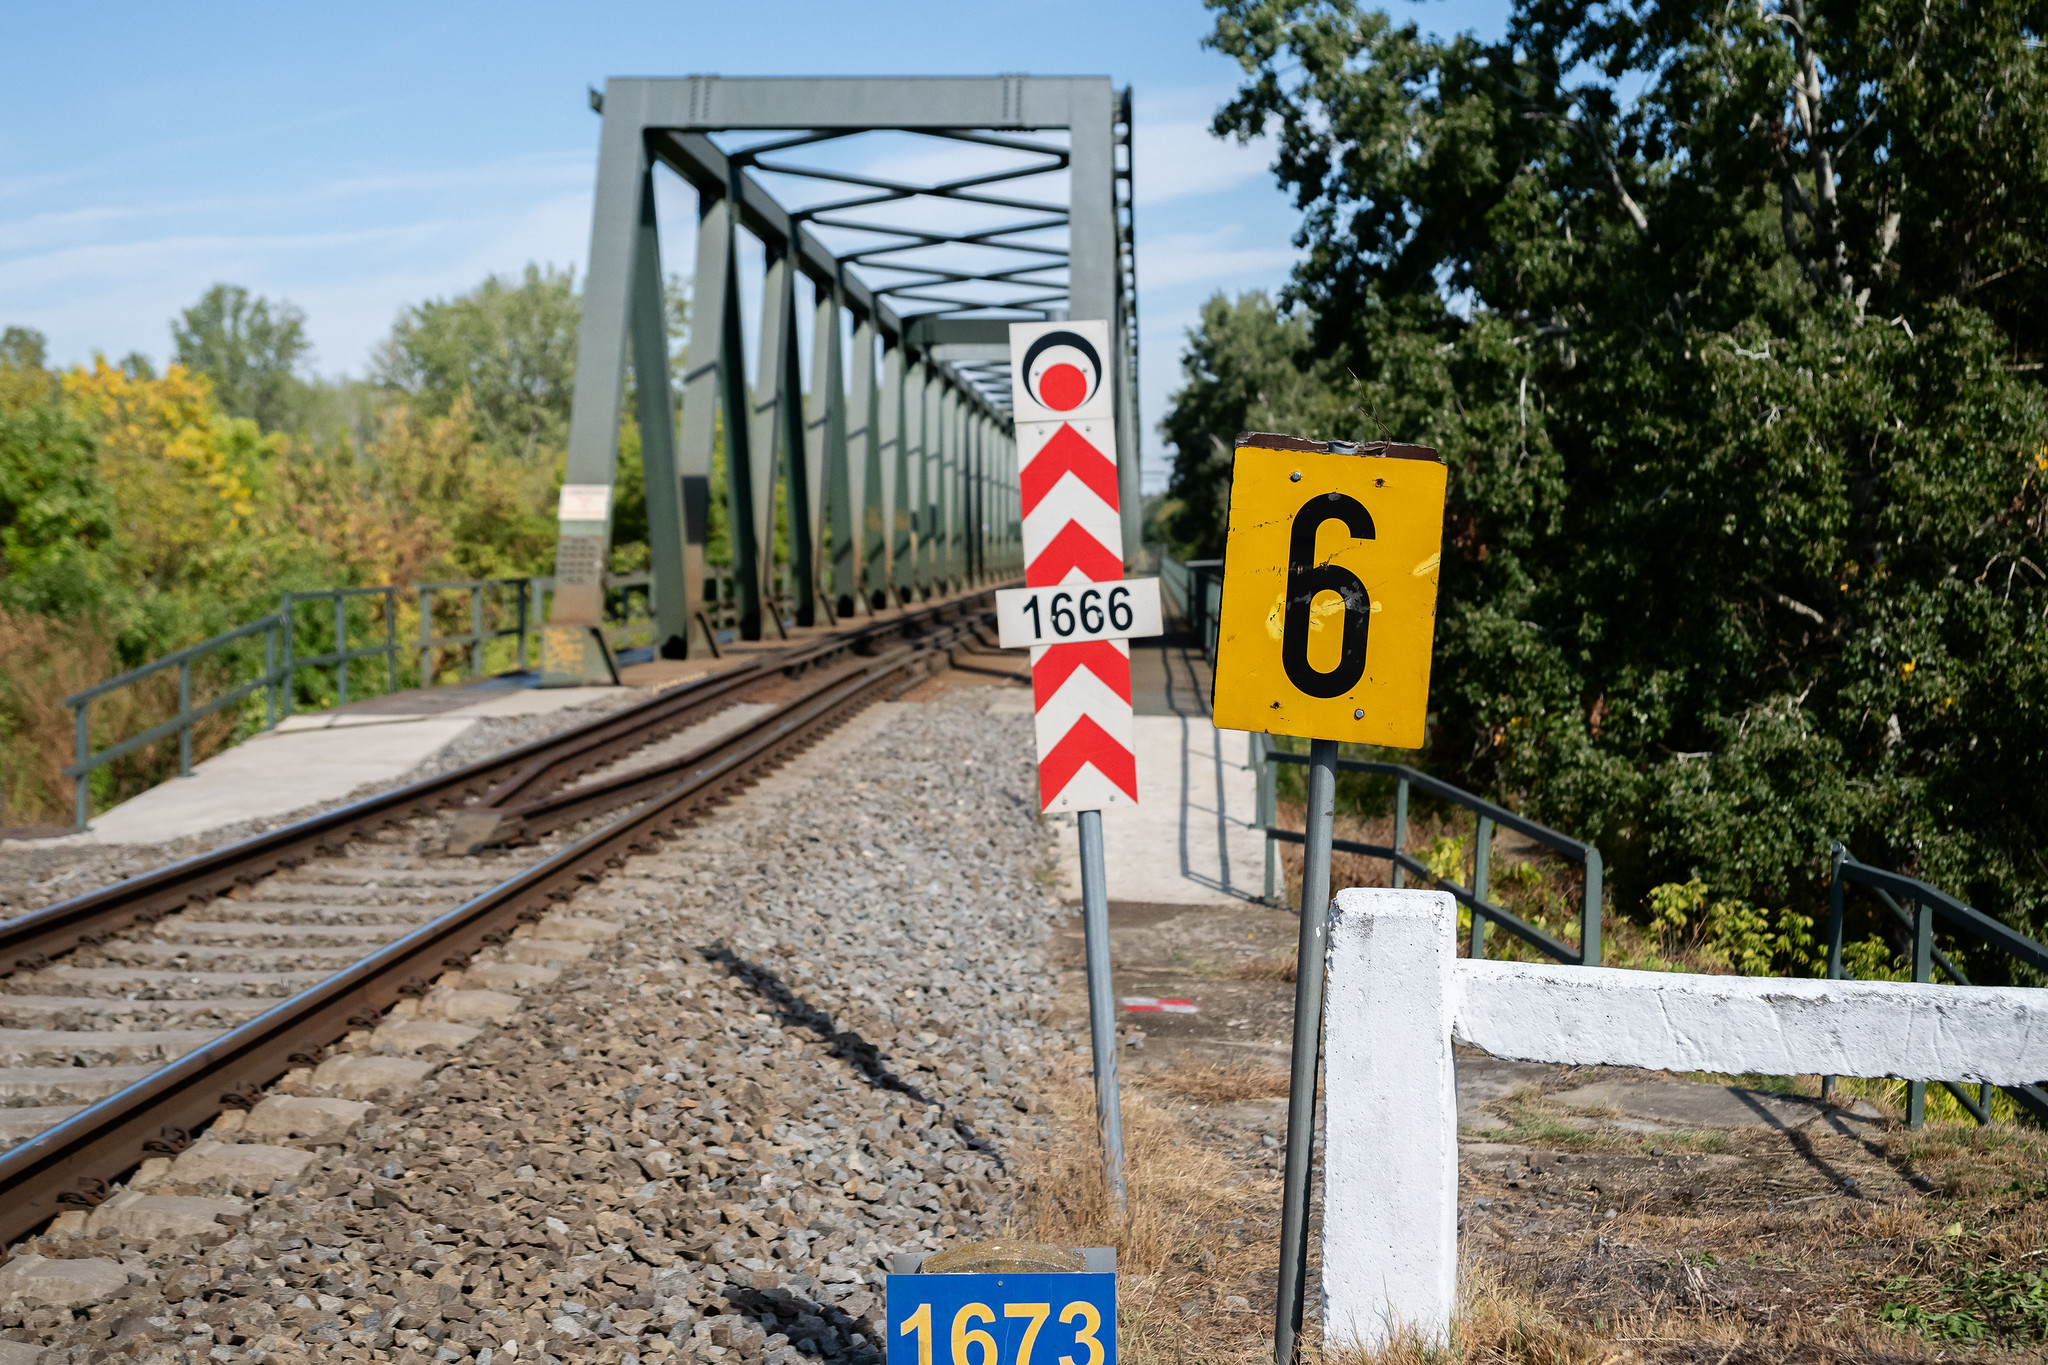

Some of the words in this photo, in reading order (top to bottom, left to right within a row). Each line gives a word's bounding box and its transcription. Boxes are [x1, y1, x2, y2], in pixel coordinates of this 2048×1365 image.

[1023, 586, 1133, 639] 1666
[1282, 492, 1376, 699] 6
[900, 1301, 1105, 1365] 1673
